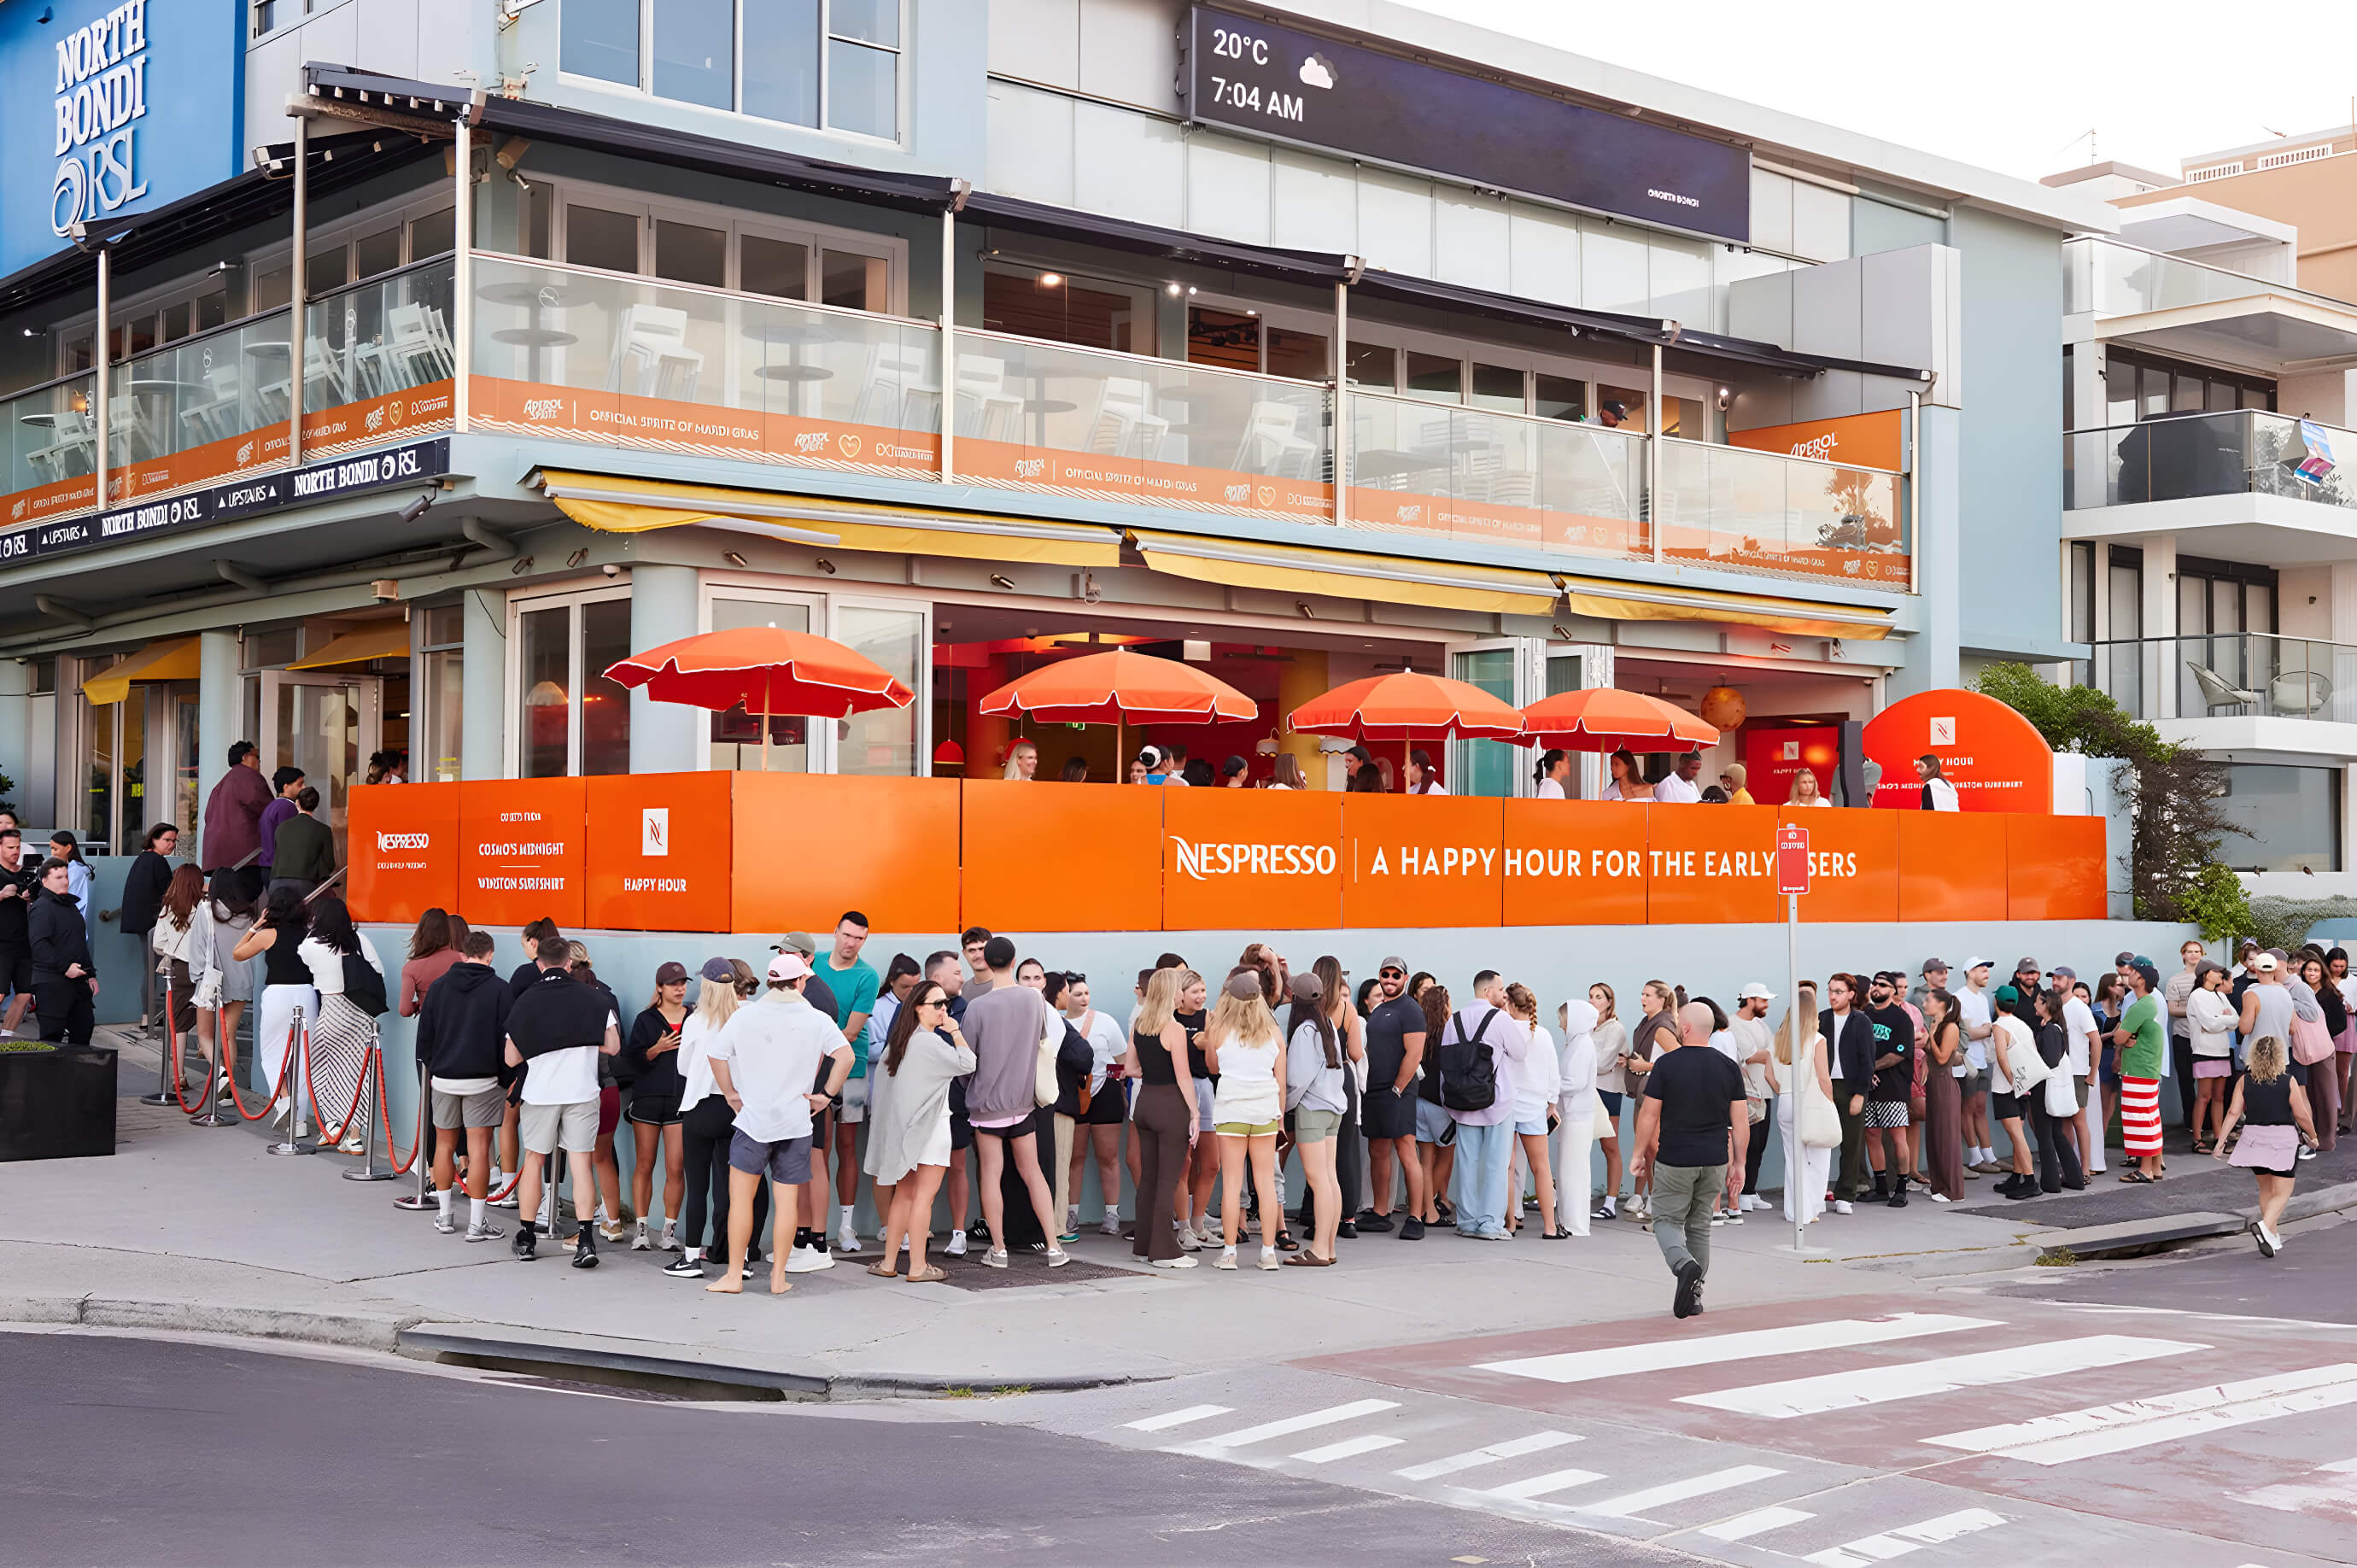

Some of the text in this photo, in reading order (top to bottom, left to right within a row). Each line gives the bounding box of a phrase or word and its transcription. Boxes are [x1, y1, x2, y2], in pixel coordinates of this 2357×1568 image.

[55, 0, 146, 95] NORTH
[1213, 28, 1268, 66] 20°C
[55, 53, 146, 158] BONDI
[1211, 76, 1303, 122] 7:04 AM
[87, 126, 148, 220] RSL
[1790, 431, 1839, 459] APEROL
[294, 449, 421, 497] NORTH BONDI RSL
[102, 497, 202, 537] NORTH BONDI RSL
[228, 485, 266, 507] UPSTAIRS
[376, 830, 429, 852] NESPRESSO
[1168, 836, 1857, 881] NESPRESSO A HAPPY HOUR FOR THE EARLY SERS
[624, 878, 687, 892] HAPPY HOUR
